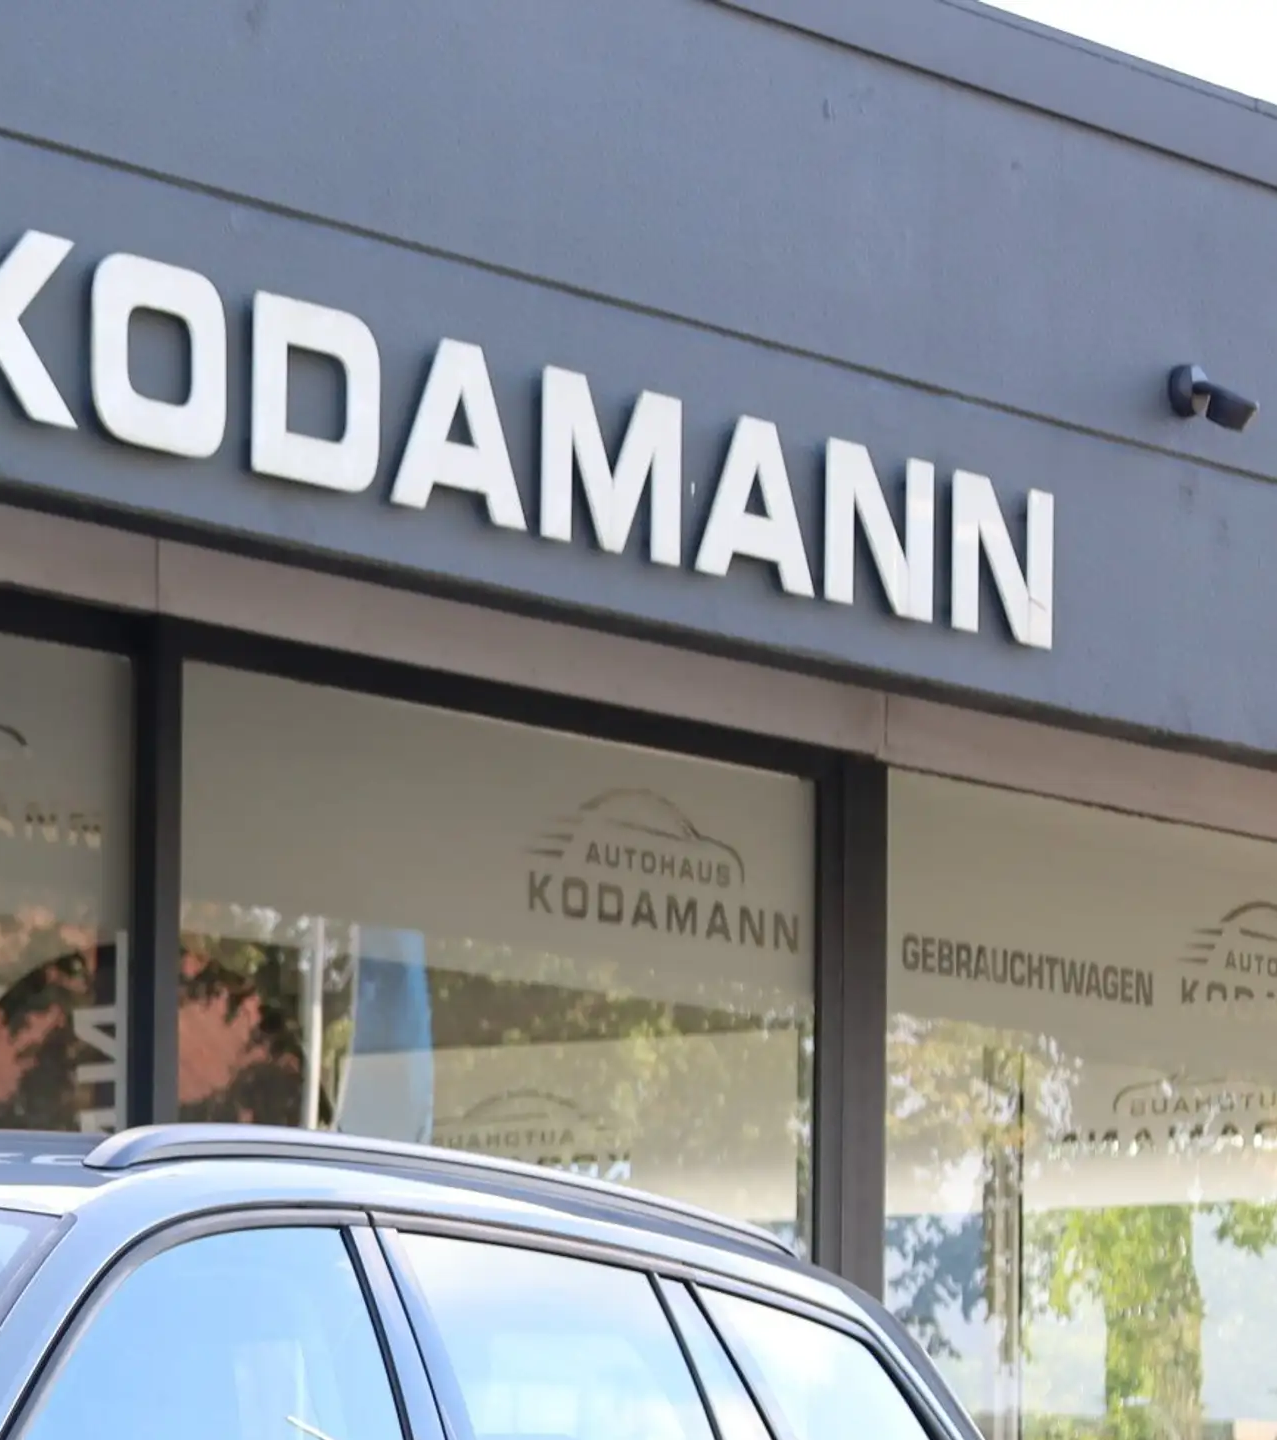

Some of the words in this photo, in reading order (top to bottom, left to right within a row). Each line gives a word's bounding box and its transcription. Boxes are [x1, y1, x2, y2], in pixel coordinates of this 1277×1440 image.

[585, 841, 731, 888] AUTOHAUS
[528, 870, 800, 955] KODAMANN
[902, 932, 1154, 1006] GEBRAUCHTWAGEN
